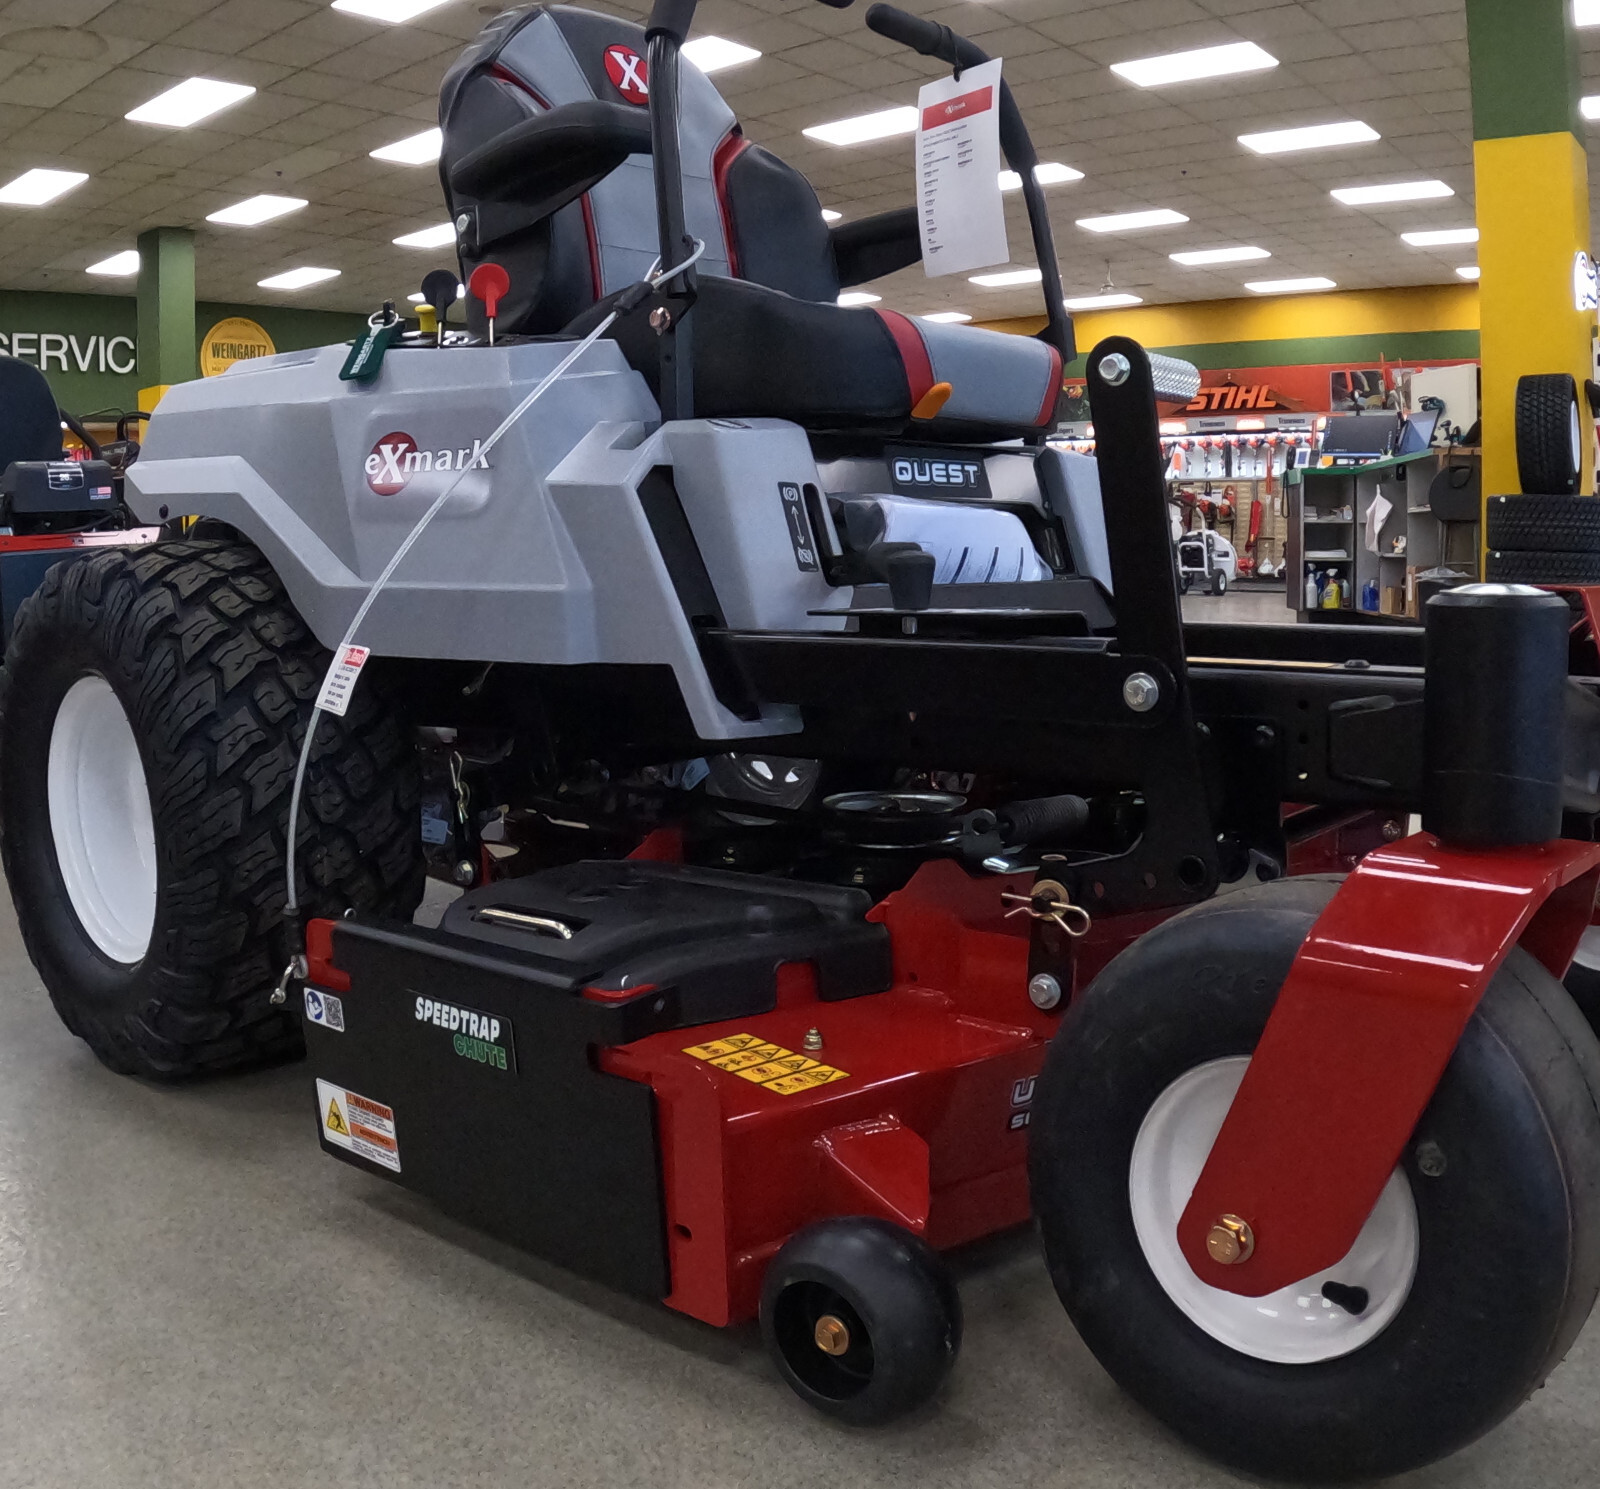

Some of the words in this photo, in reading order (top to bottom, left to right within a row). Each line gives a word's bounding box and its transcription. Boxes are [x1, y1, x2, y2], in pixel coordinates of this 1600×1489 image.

[0, 332, 138, 374] ERVIC
[211, 342, 267, 360] WEINGARTZ
[1186, 385, 1277, 411] STIHL
[364, 440, 492, 484] eXmark
[893, 459, 979, 485] QUEST
[415, 996, 500, 1043] SPEEDTRAP
[453, 1033, 508, 1070] CHUTE
